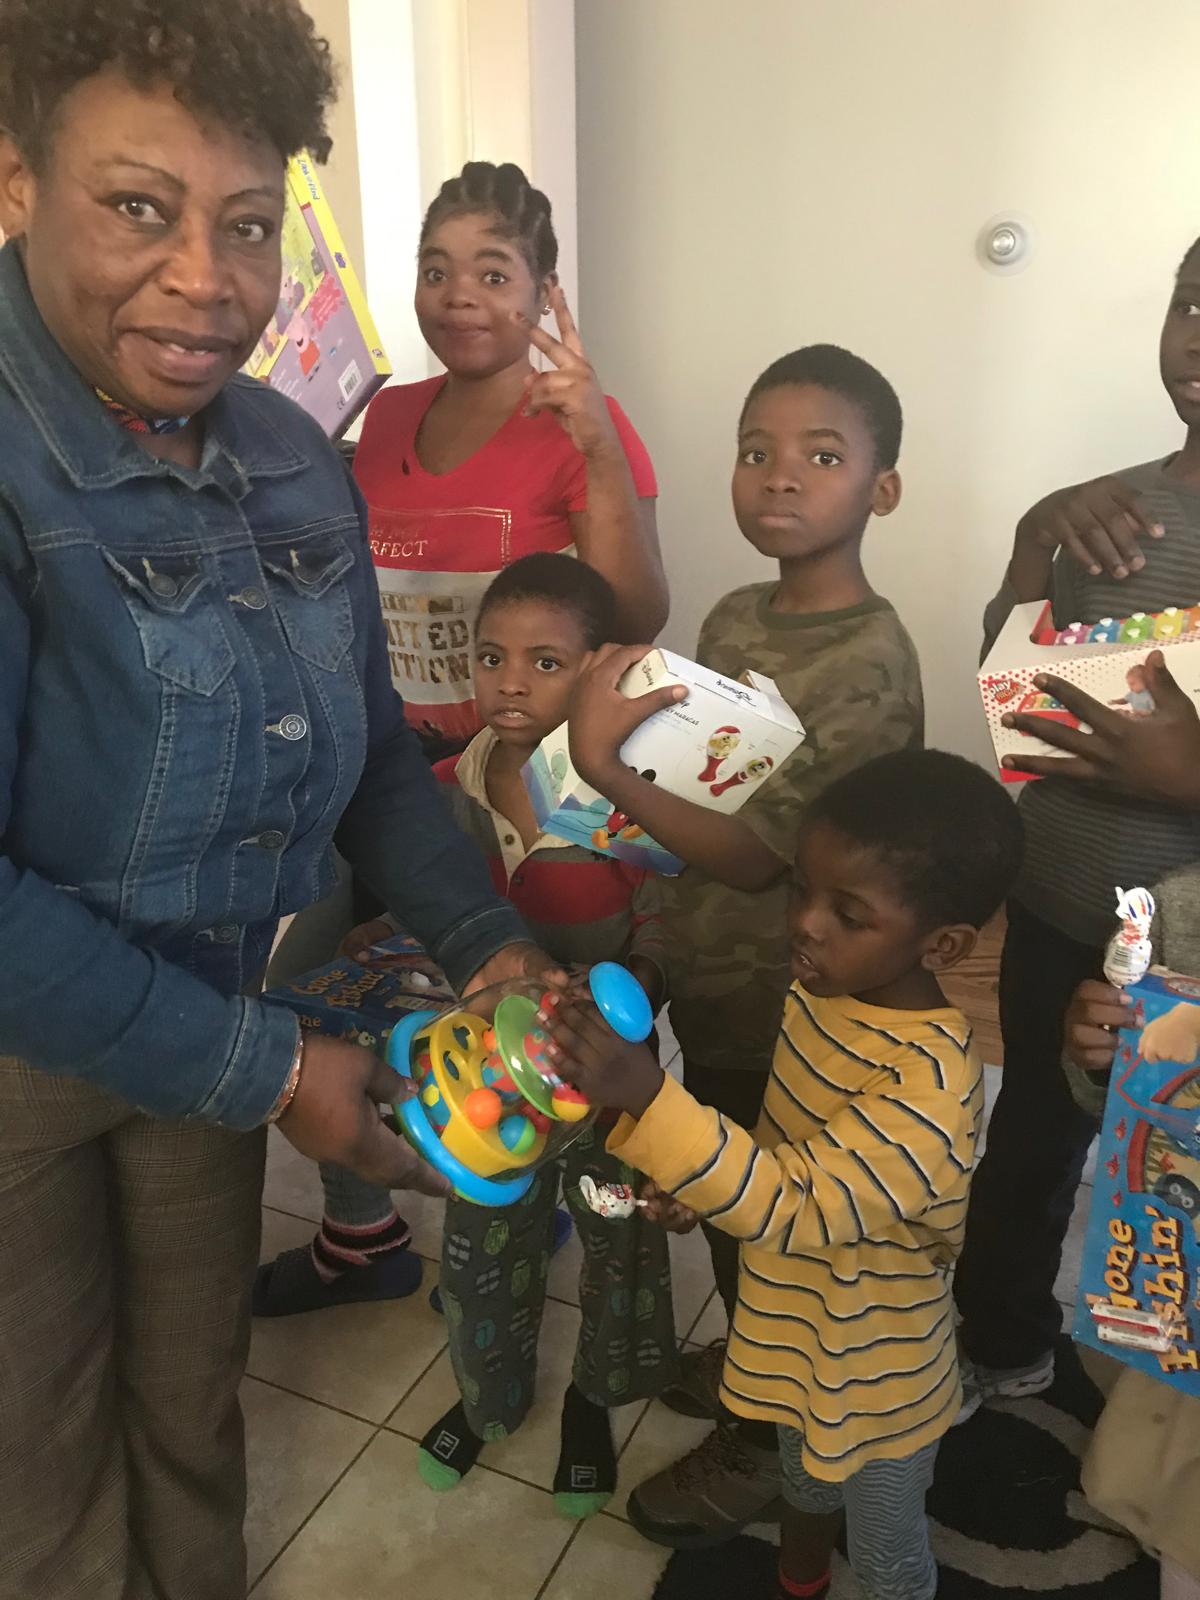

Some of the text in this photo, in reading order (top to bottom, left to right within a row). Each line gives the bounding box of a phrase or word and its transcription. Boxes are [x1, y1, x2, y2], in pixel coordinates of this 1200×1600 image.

[370, 540, 428, 558] RFECT
[386, 619, 470, 650] ITED
[390, 651, 472, 684] ITION
